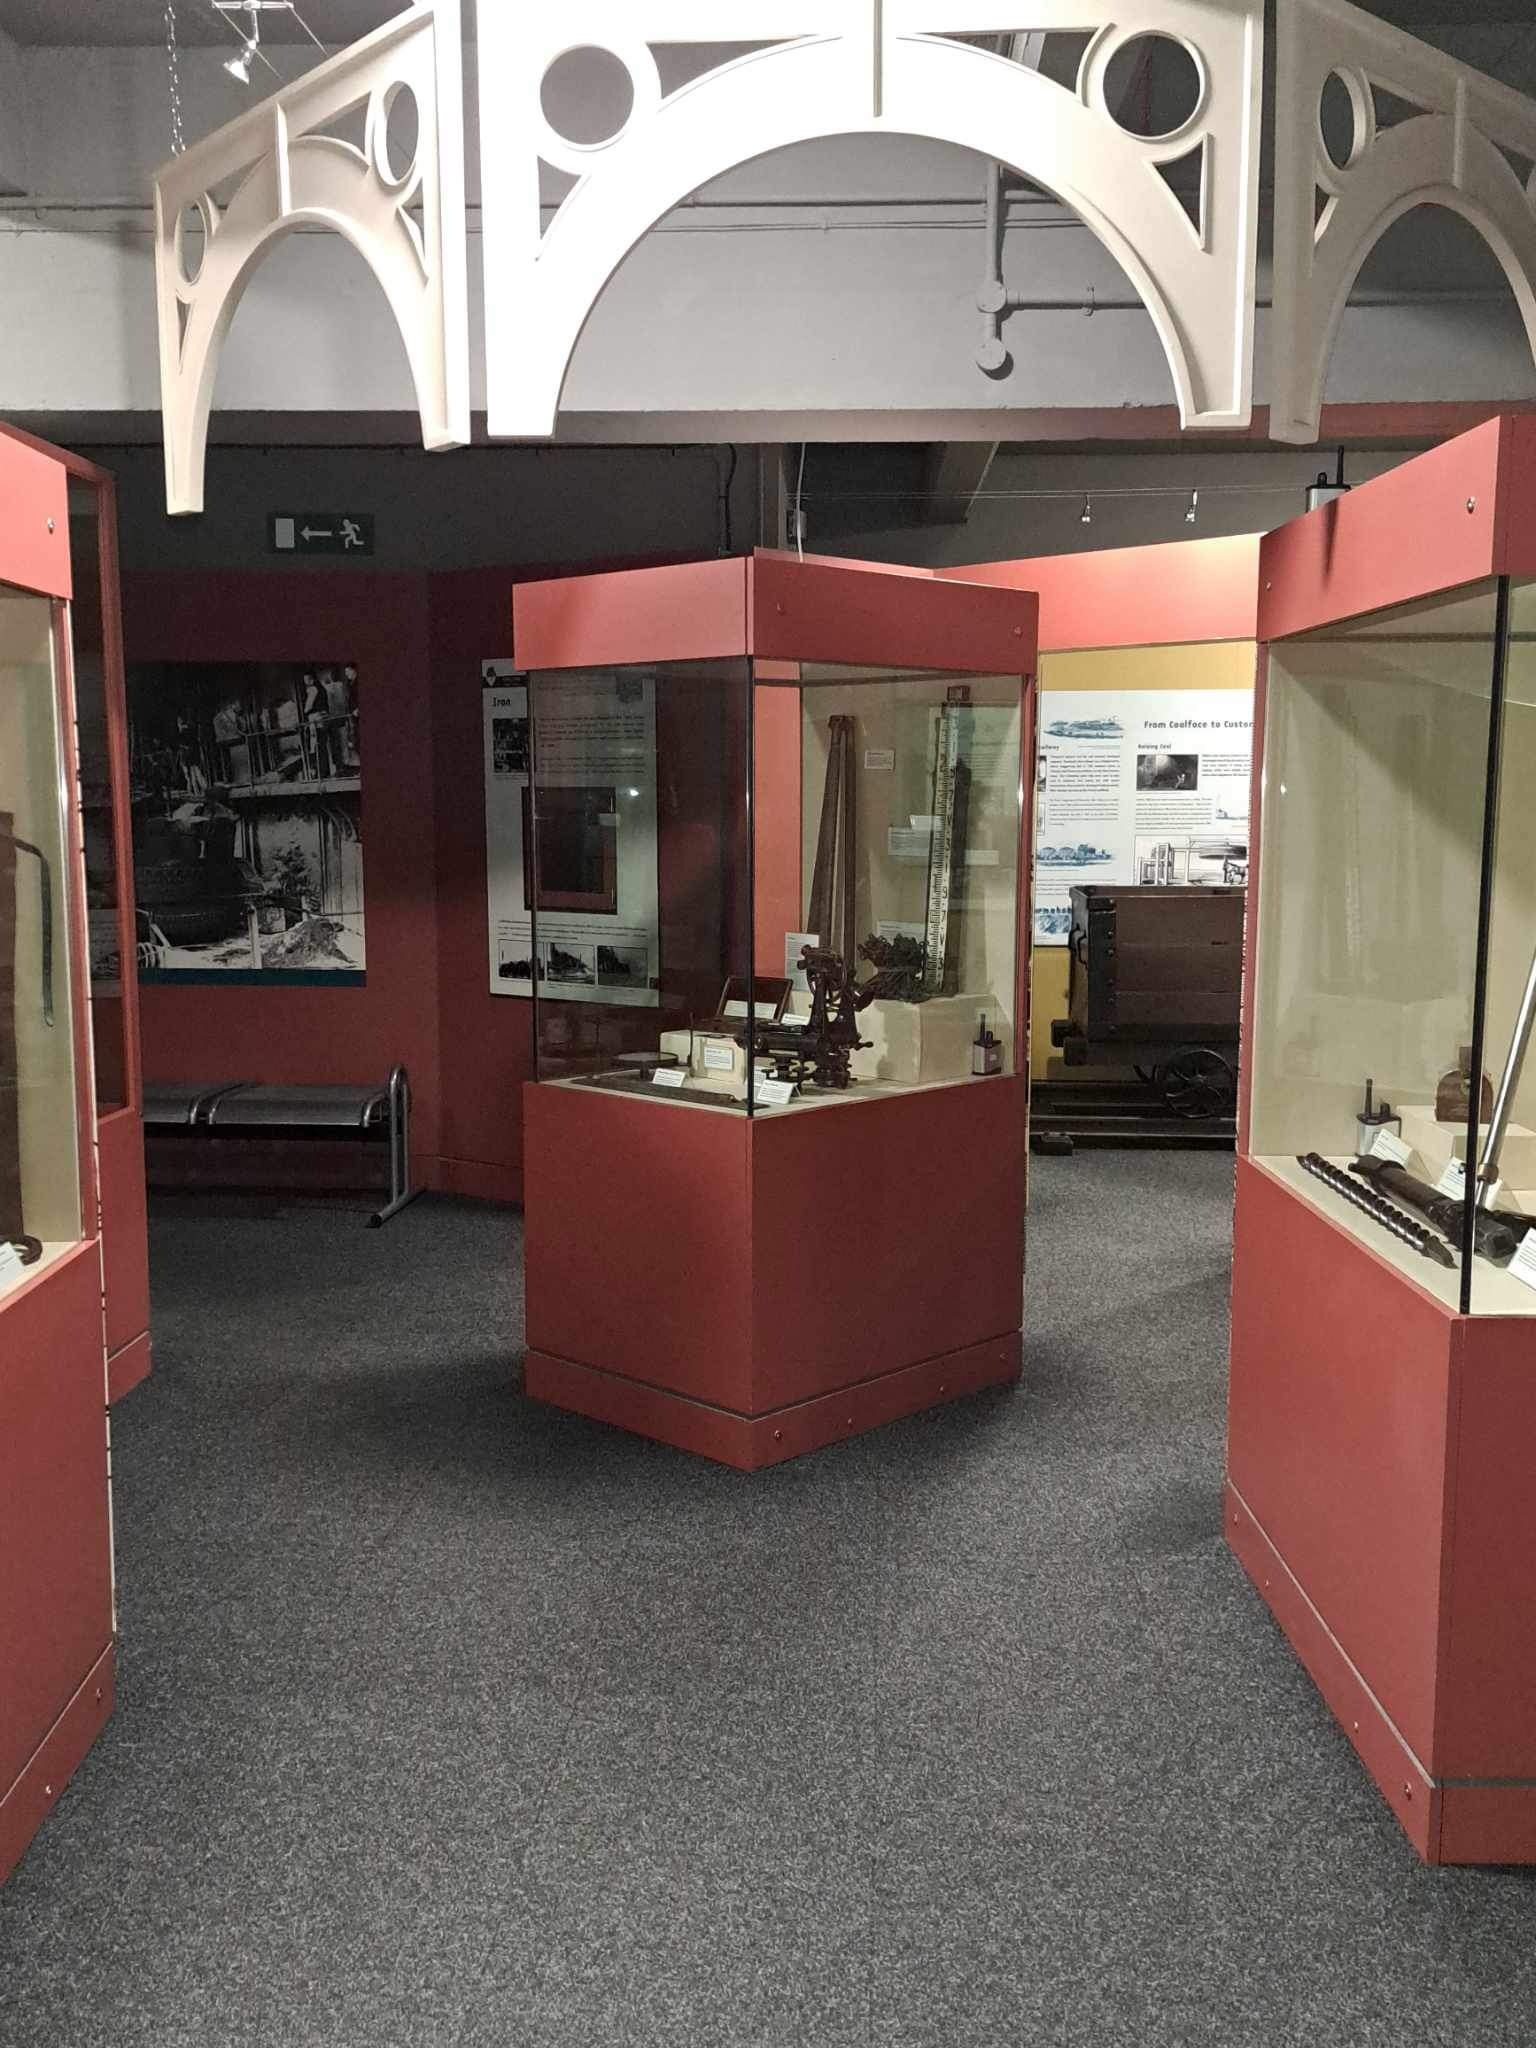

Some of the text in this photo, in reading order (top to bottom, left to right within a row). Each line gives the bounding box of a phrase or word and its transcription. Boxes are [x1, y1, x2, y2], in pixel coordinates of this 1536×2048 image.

[493, 696, 511, 707] Iron
[1144, 720, 1166, 729] From
[1169, 719, 1207, 729] Coalface
[1211, 720, 1221, 729] to
